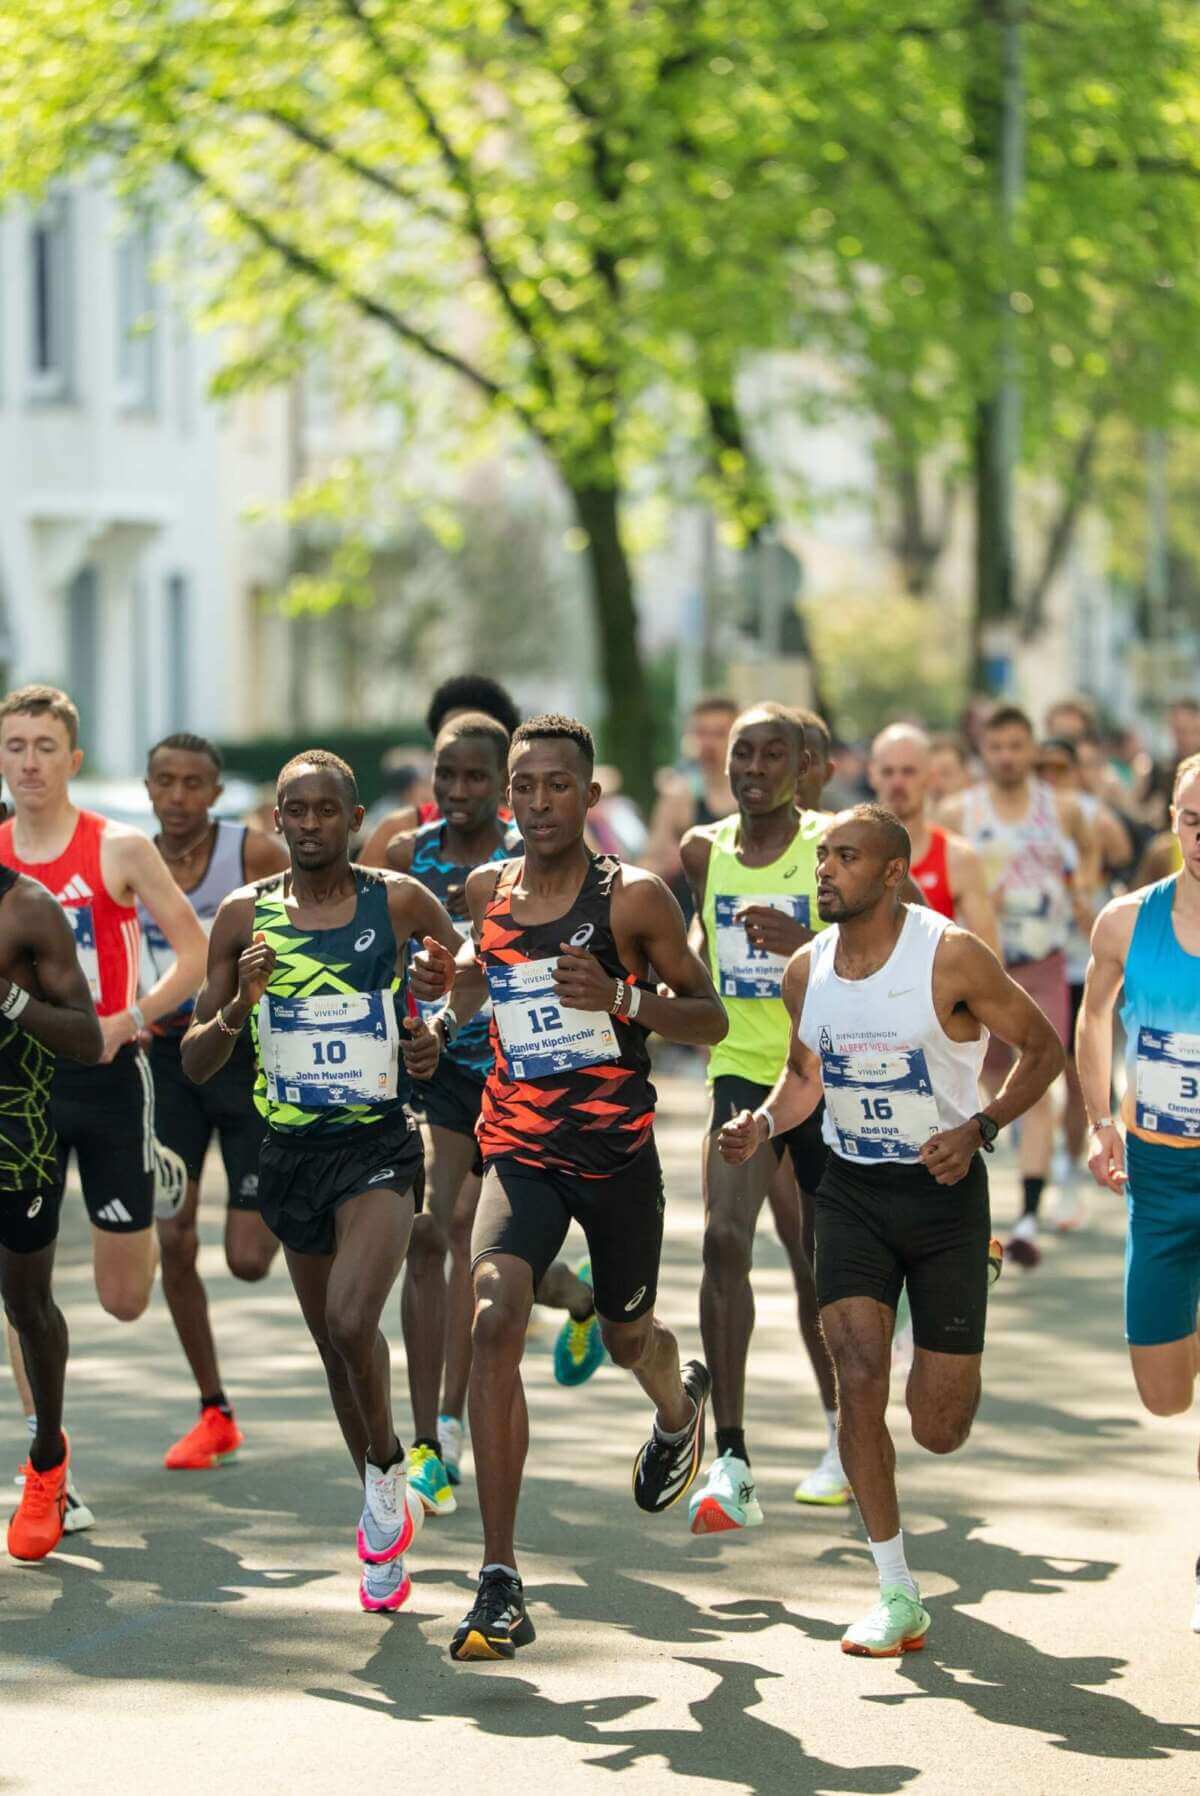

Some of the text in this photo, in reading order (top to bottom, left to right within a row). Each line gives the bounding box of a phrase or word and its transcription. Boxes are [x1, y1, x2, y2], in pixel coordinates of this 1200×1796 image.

[521, 974, 552, 985] VIVEND
[313, 1008, 348, 1017] VIVENDI
[527, 1005, 563, 1034] 12
[375, 1021, 384, 1032] A
[509, 1028, 595, 1054] Stanley Kipchirchir
[312, 1040, 347, 1065] 10
[839, 1042, 867, 1052] ALBERT
[296, 1069, 362, 1080] John Mwaniki
[1179, 1075, 1199, 1099] 3
[860, 1098, 893, 1120] 16
[861, 1126, 899, 1136] Abdi Uya
